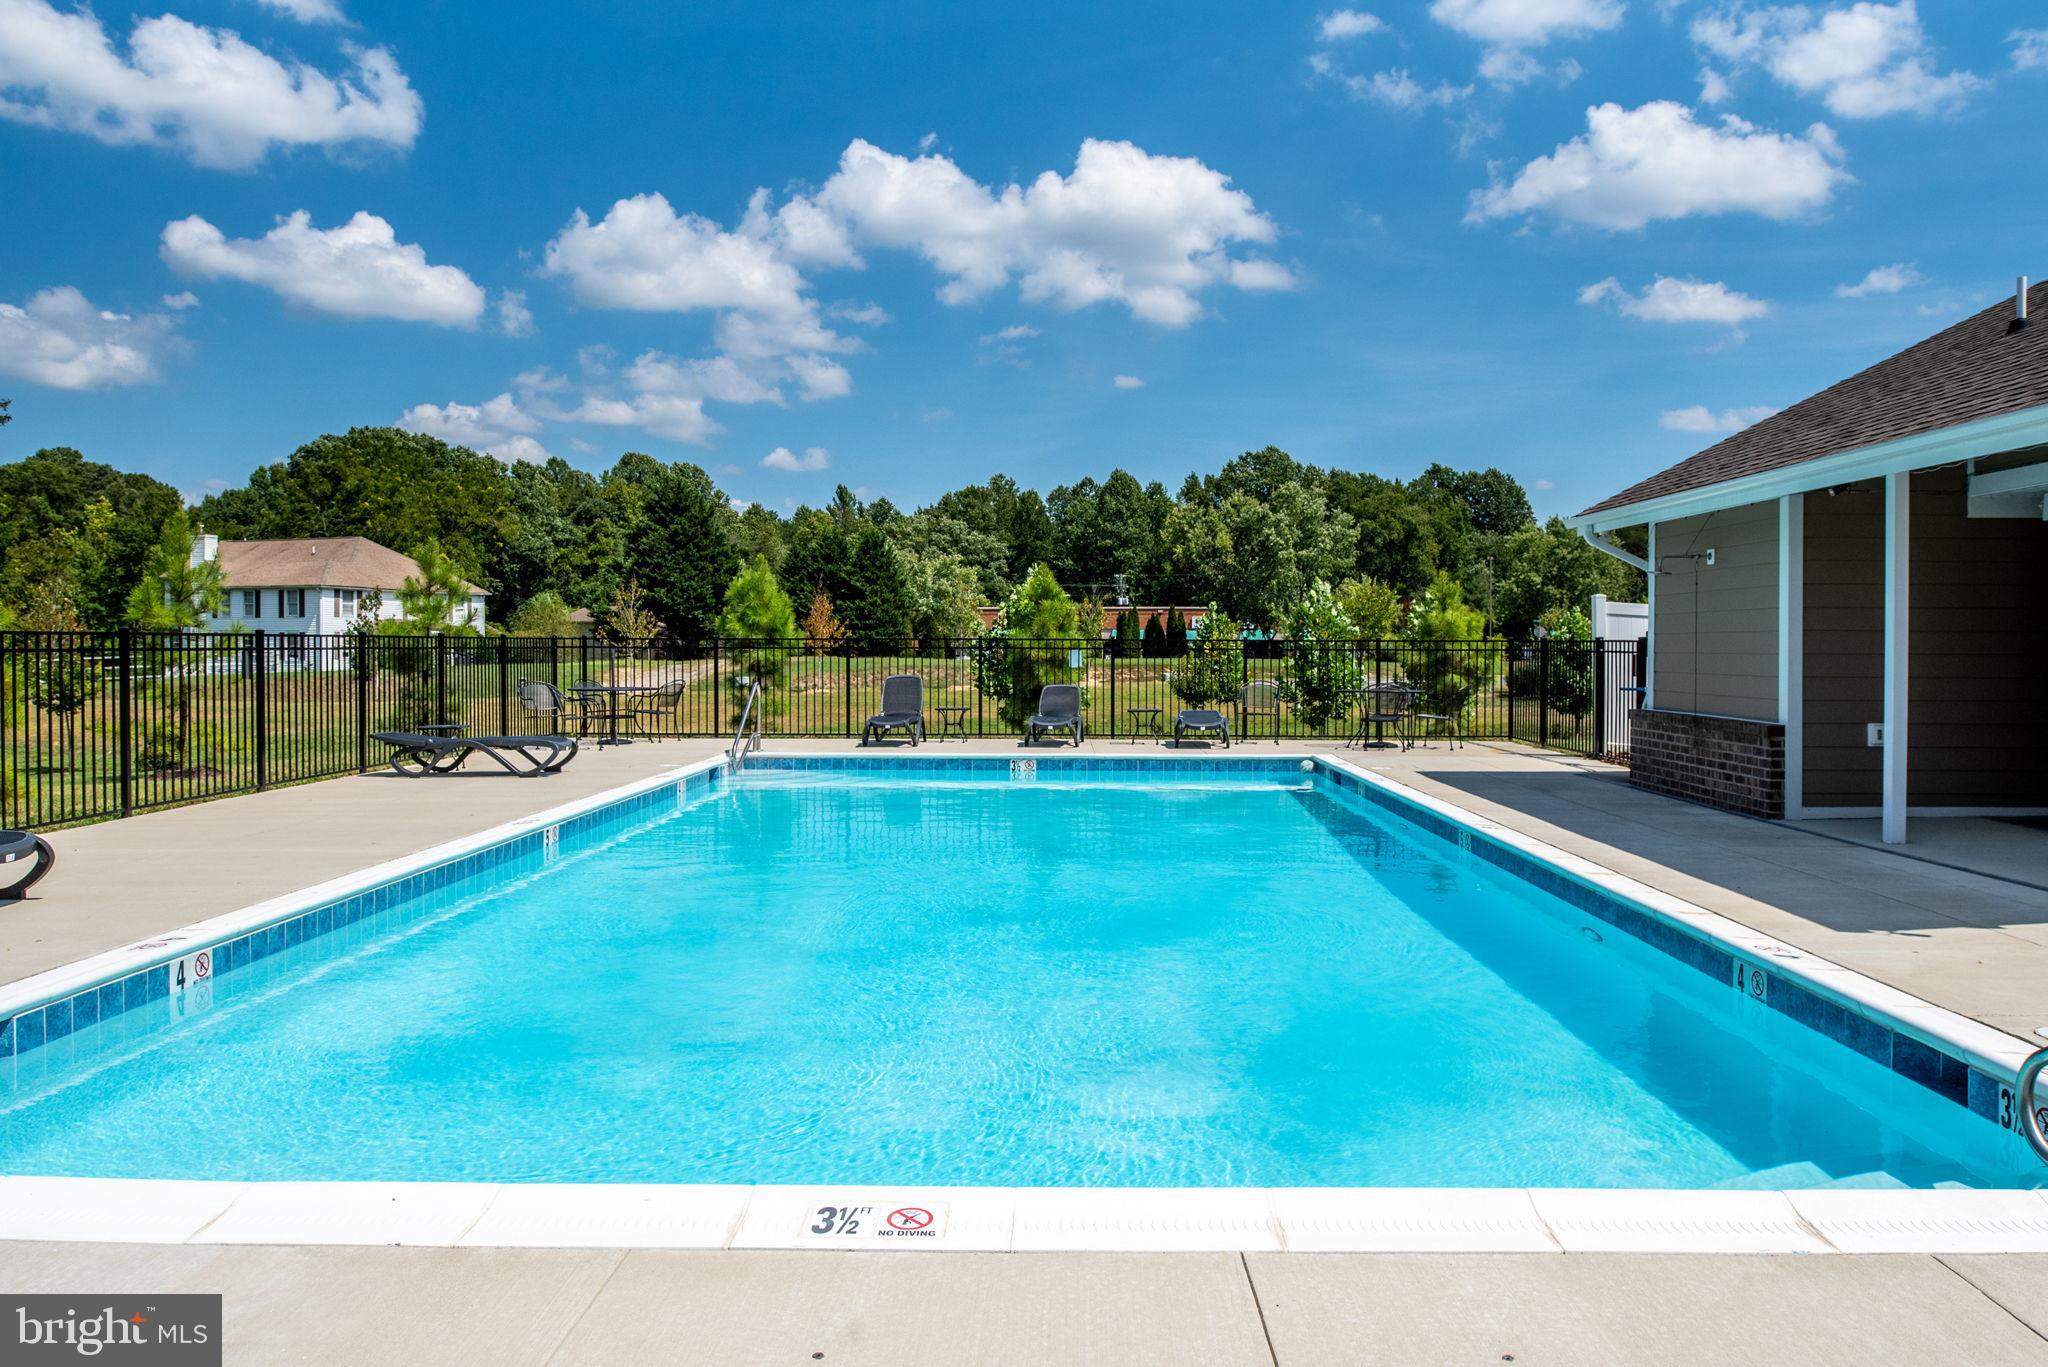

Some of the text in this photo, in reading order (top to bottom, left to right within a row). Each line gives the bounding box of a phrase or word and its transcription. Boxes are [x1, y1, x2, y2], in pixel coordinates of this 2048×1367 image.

[176, 960, 186, 990] 4
[1737, 963, 1745, 993] 4
[860, 1206, 874, 1215] FT
[878, 1229, 937, 1238] NO DIVING
